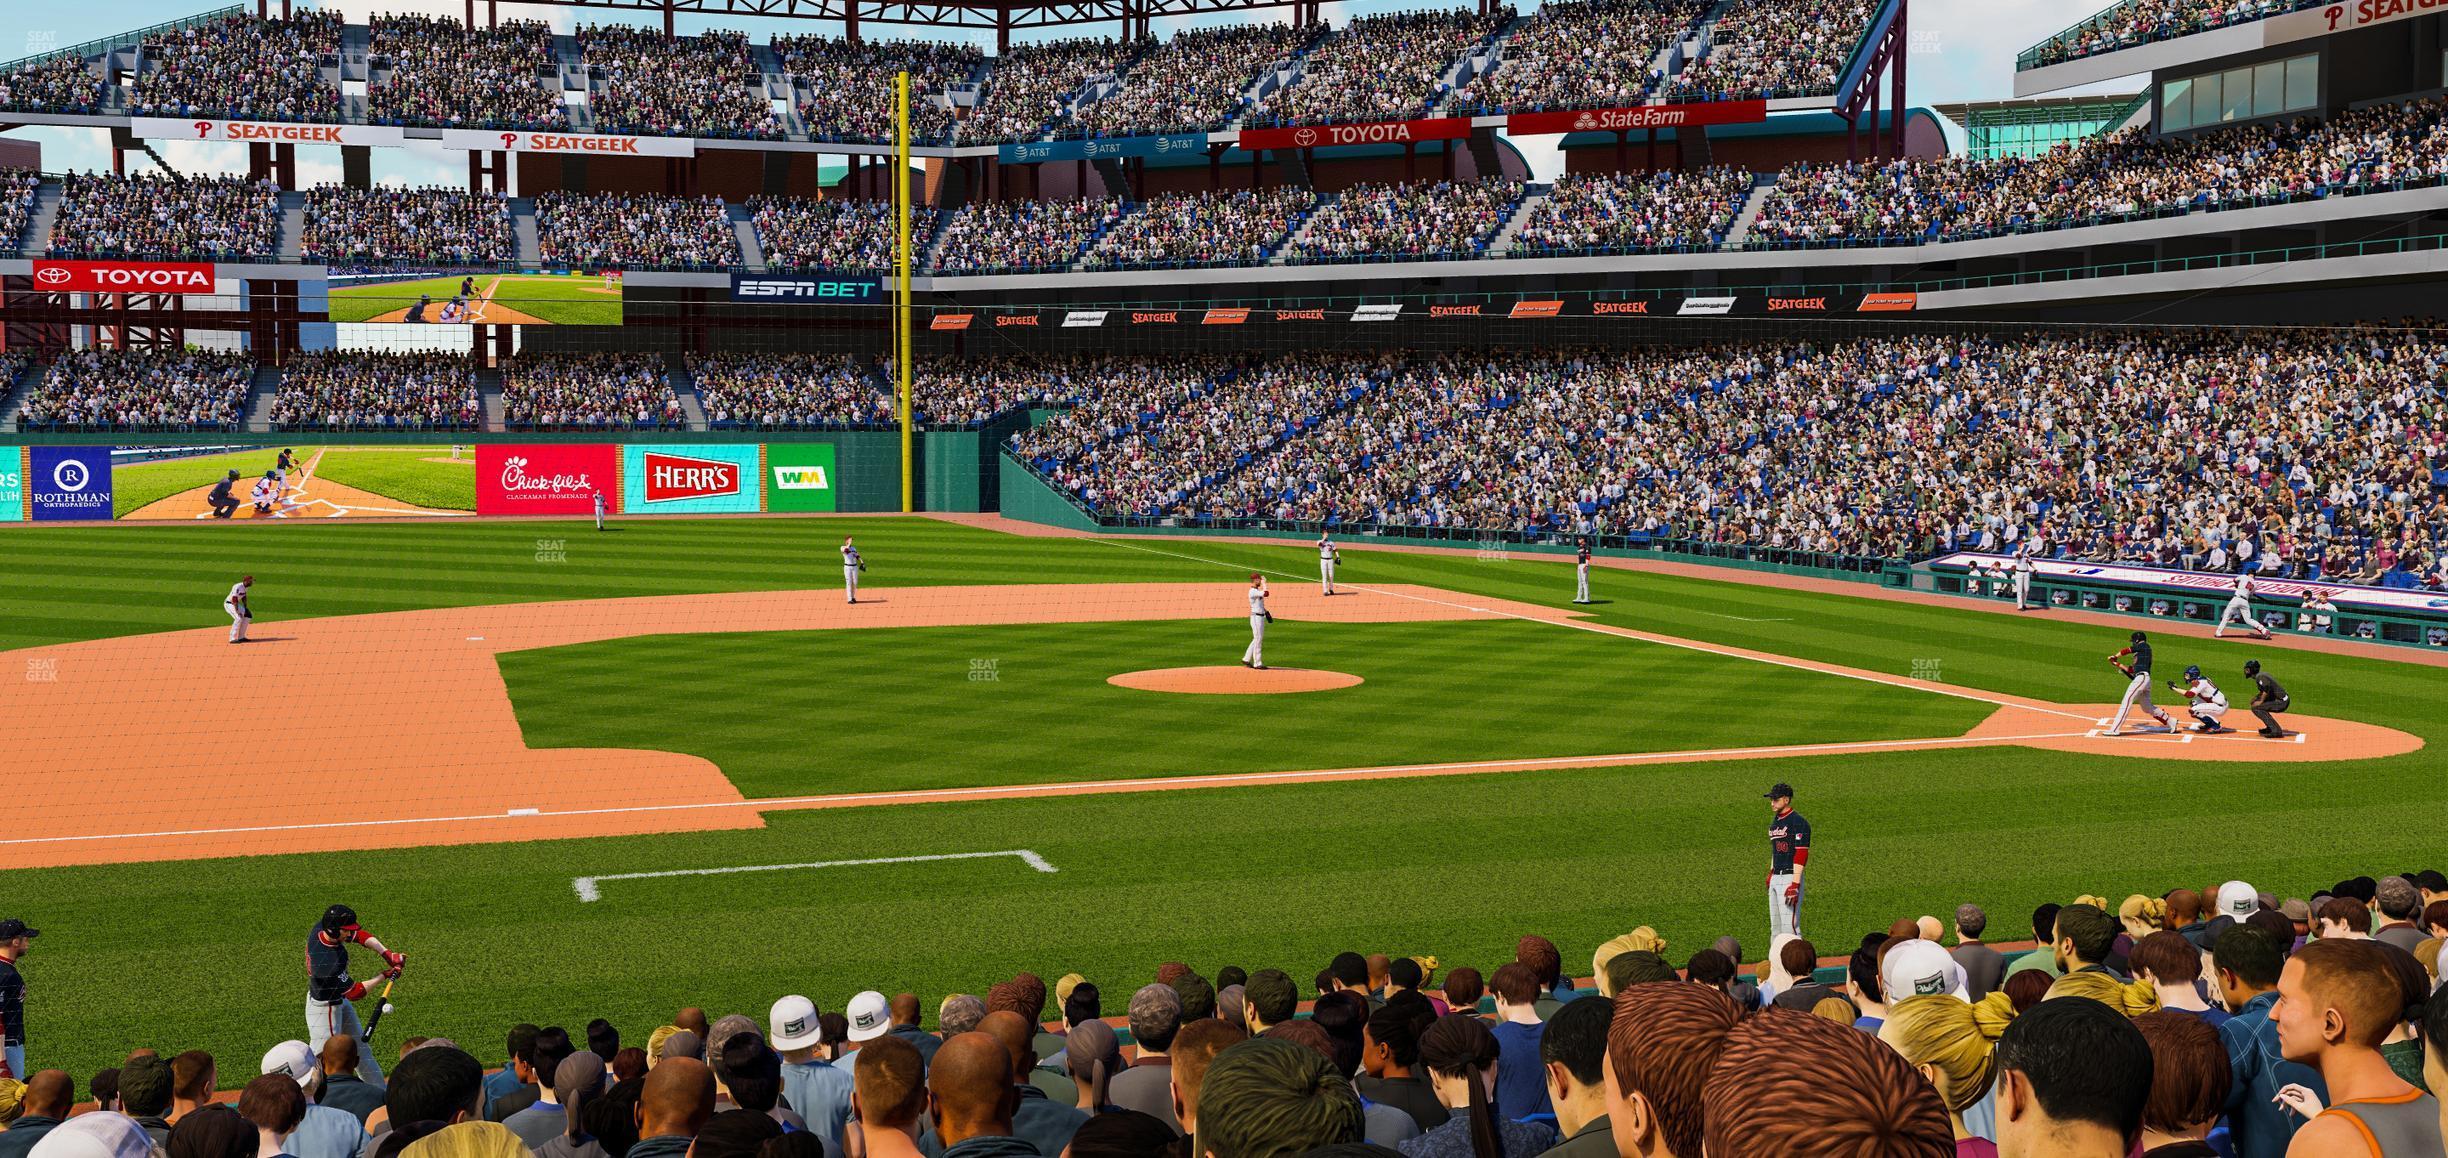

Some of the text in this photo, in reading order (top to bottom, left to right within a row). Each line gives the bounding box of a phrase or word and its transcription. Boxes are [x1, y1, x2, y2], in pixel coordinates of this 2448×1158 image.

[227, 122, 344, 143] SEATGEEK
[1330, 124, 1410, 143] TOYOTA
[530, 134, 639, 153] SEATGEEK
[1098, 143, 1121, 153] AT&T
[1170, 139, 1194, 149] AT&T
[1029, 148, 1051, 157] AT&T
[91, 269, 209, 286] TOYOTA
[738, 280, 875, 297] ESPN BET
[1593, 301, 1648, 314] SEATGEEK
[1768, 297, 1826, 310] SEATGEEK
[1132, 311, 1178, 324] SEATGEEK
[1276, 308, 1325, 320] SEATGEEK
[1430, 304, 1480, 318] SEATGEEK
[996, 315, 1038, 327] SEATGEEK
[501, 464, 592, 492] Chick-fil-A
[653, 465, 730, 491] HERR'S
[782, 472, 820, 483] WM
[34, 492, 110, 502] ROTHMAN
